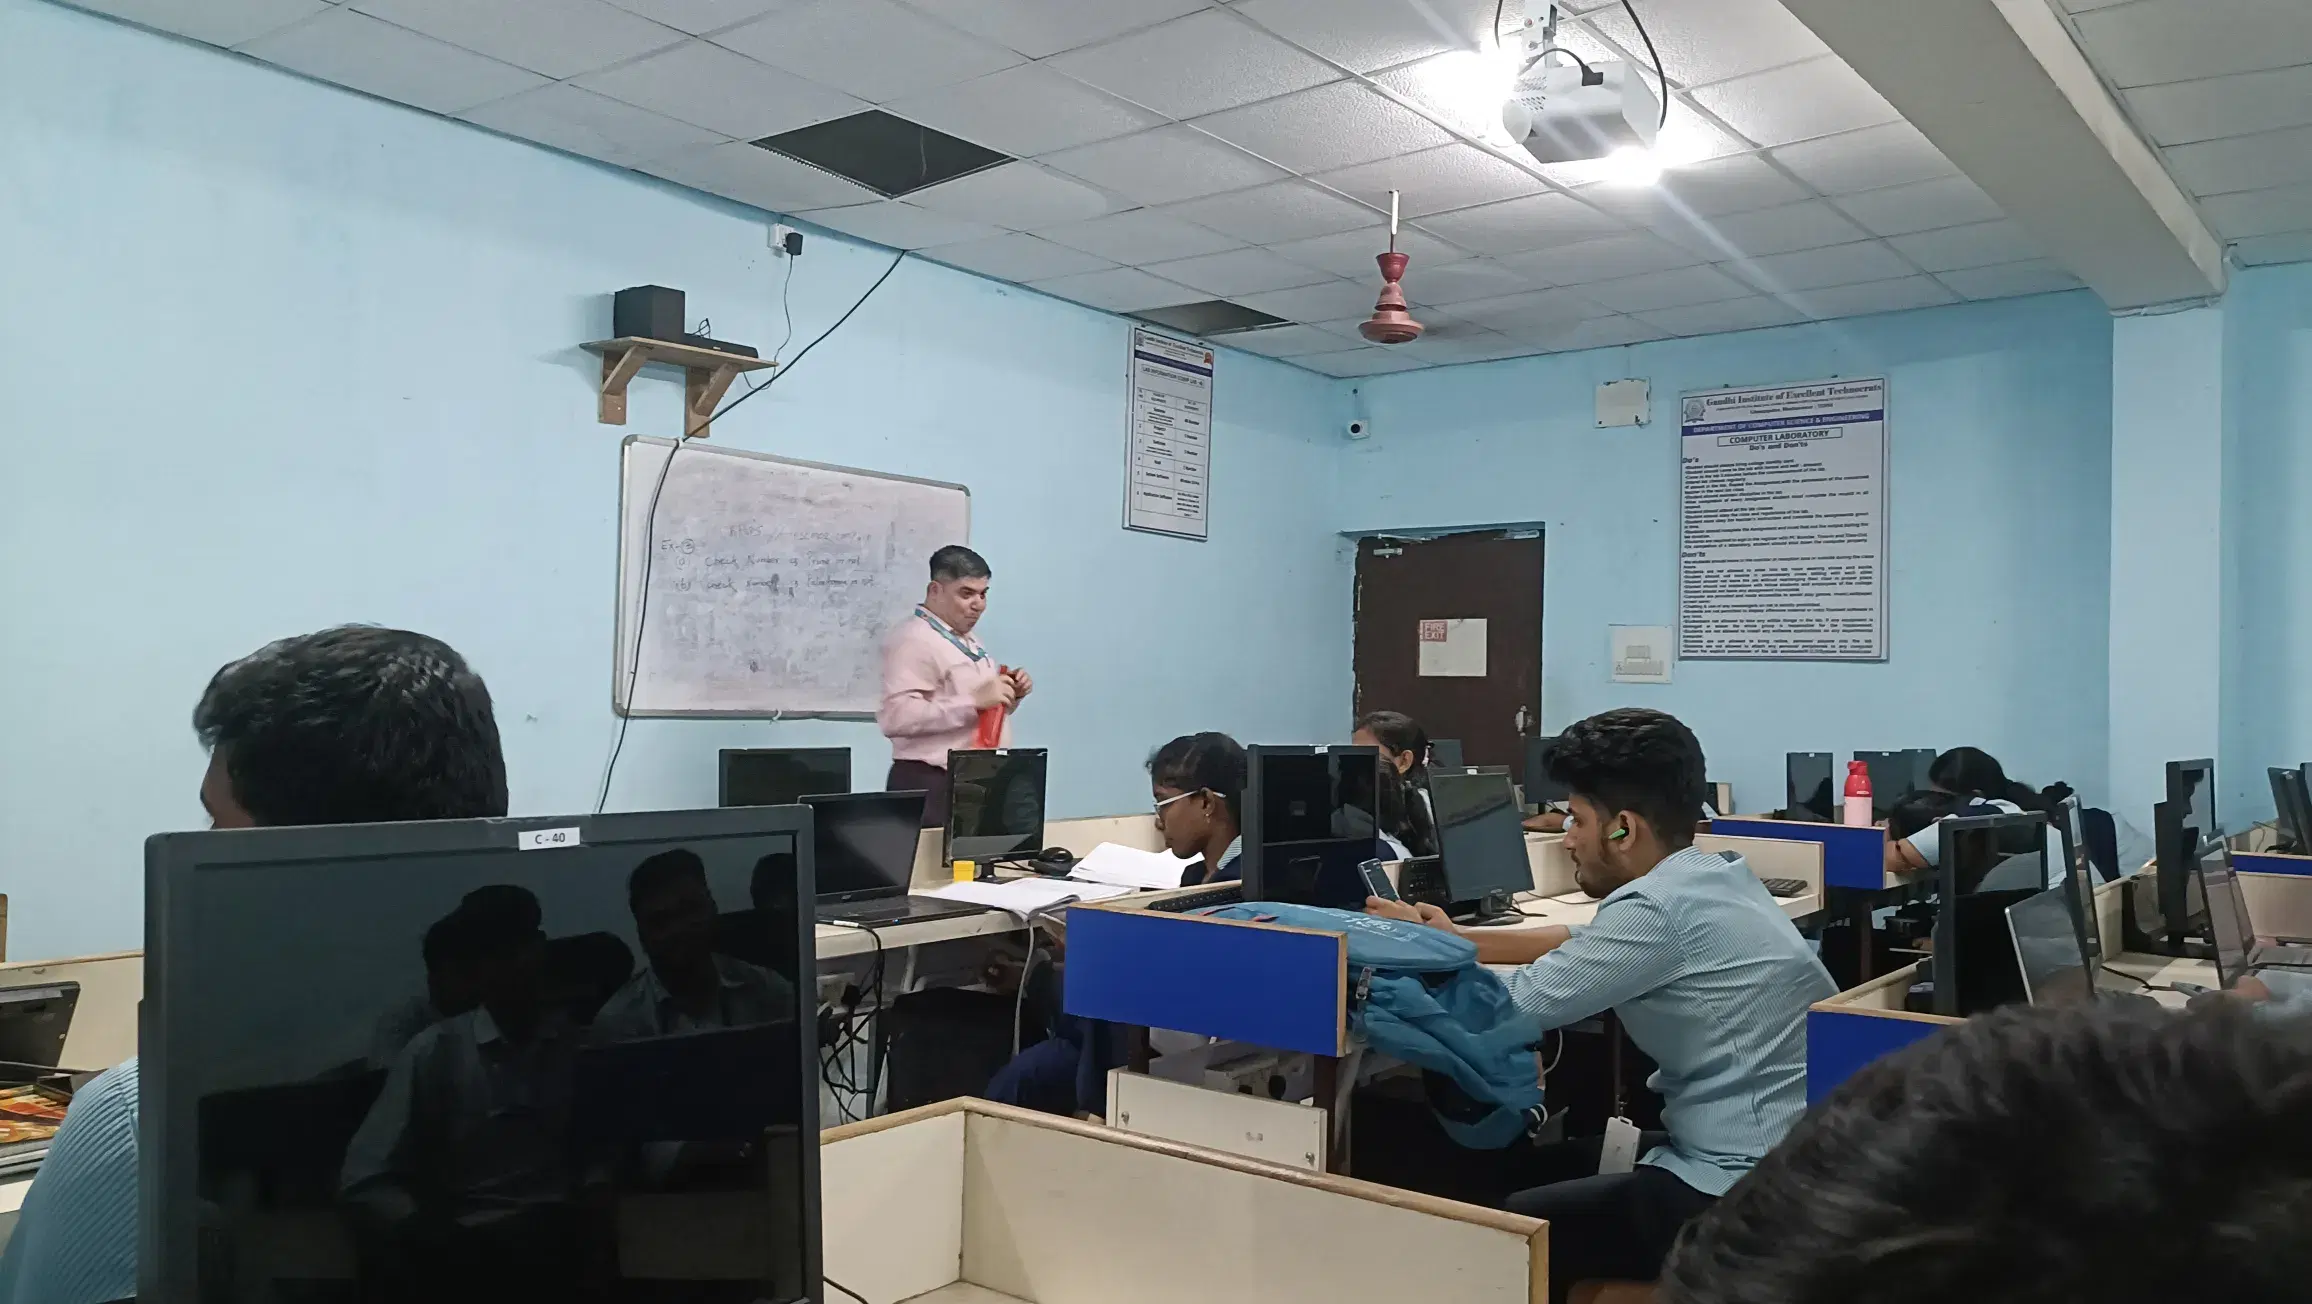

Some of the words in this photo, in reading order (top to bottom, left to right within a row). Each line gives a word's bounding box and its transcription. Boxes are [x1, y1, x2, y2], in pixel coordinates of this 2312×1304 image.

[1738, 393, 1774, 404] Institute
[1729, 434, 1773, 444] COMPUTER
[1775, 430, 1830, 441] LABORATORY
[1425, 623, 1445, 631] FIRE
[1425, 631, 1445, 640] EXIT
[535, 834, 542, 844] C
[552, 833, 566, 843] 40
